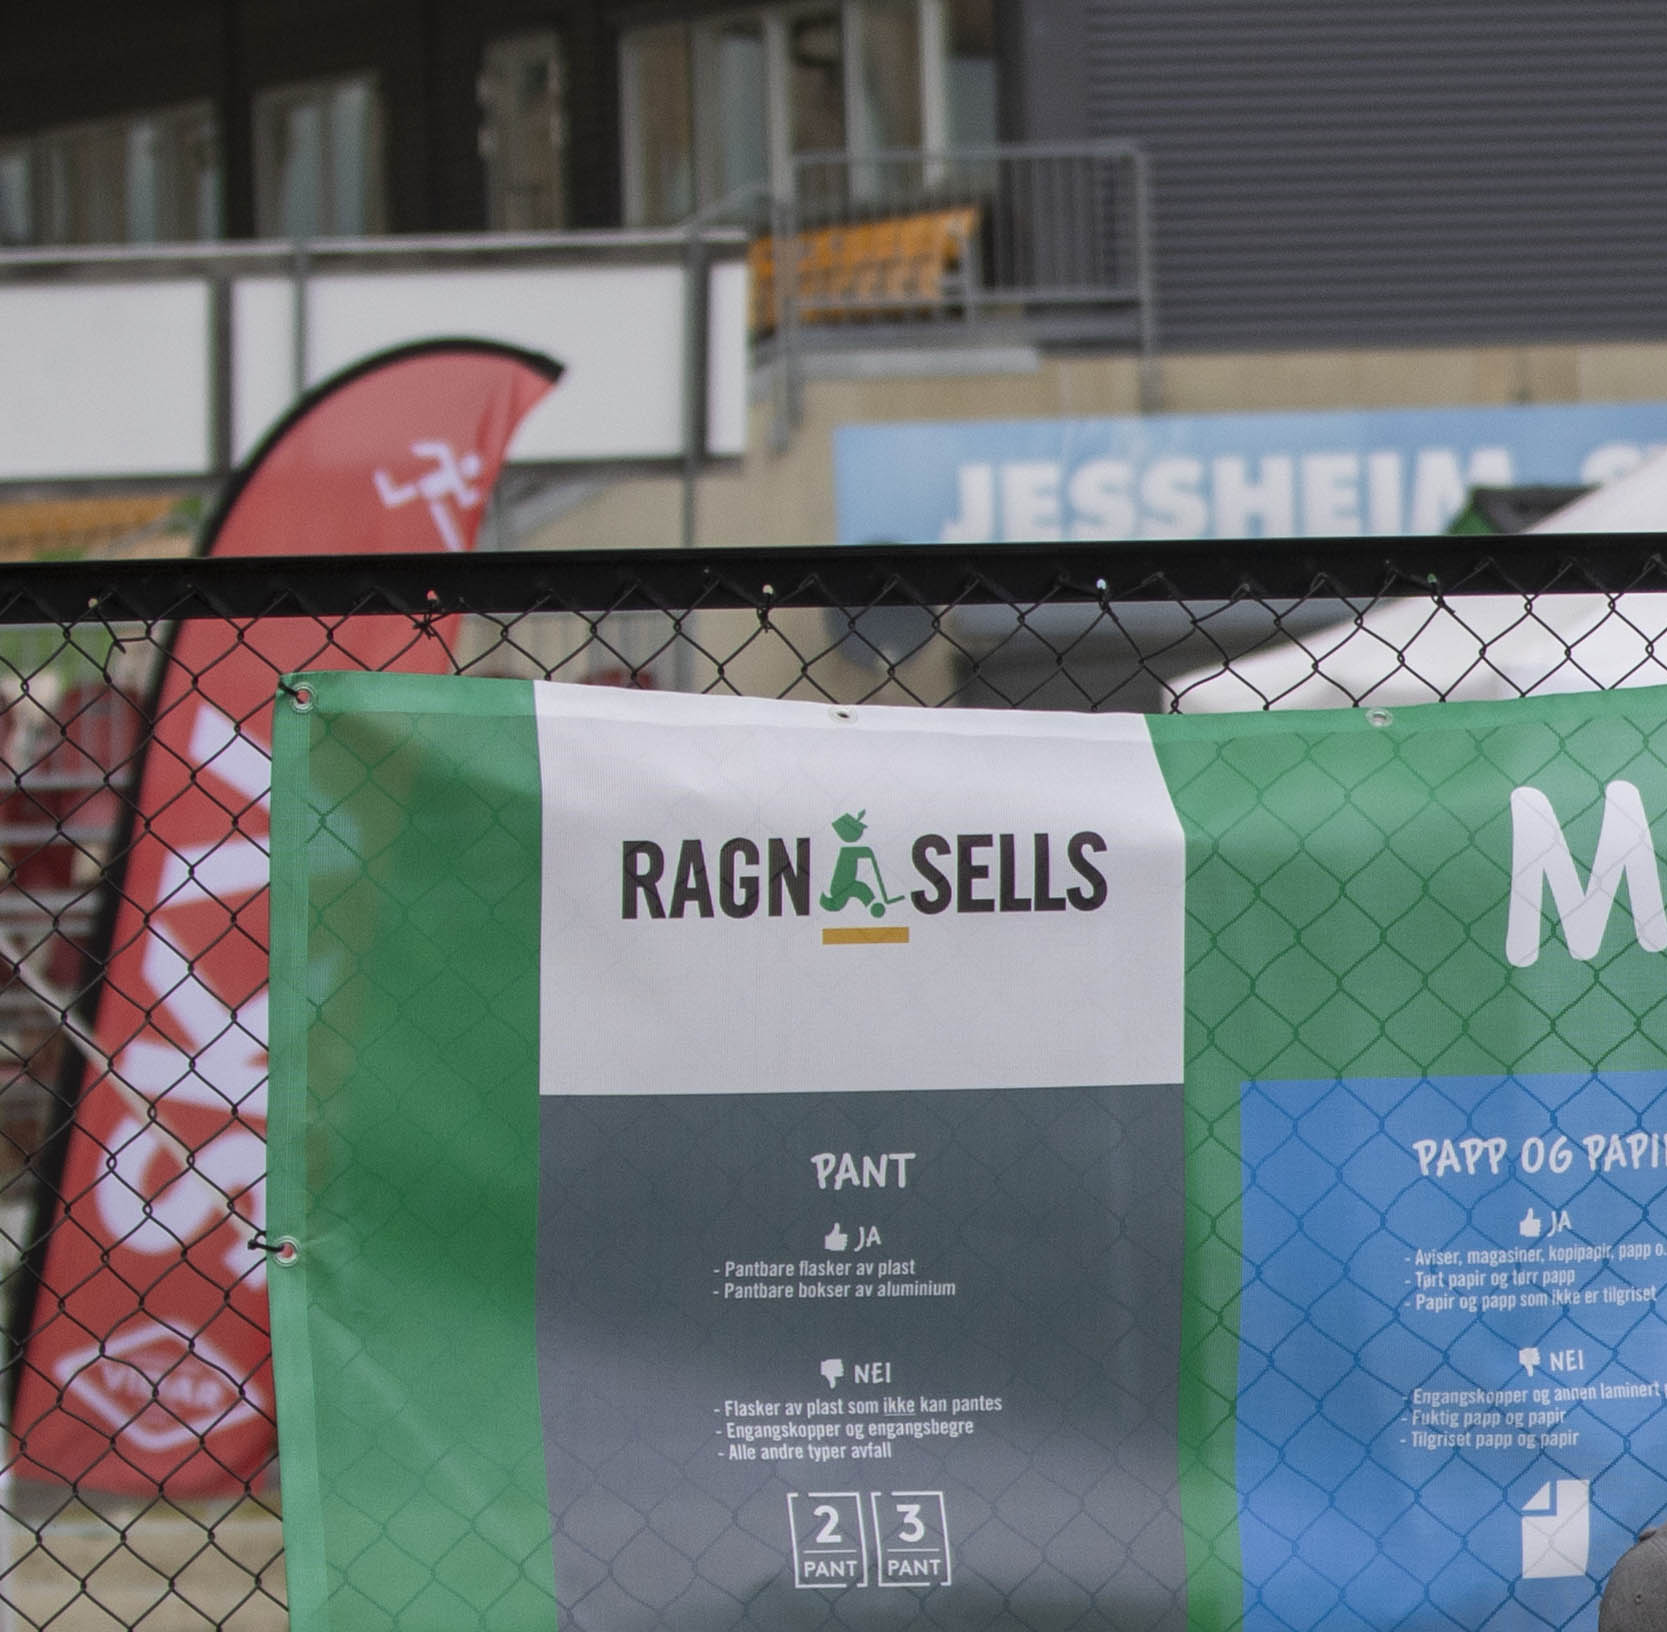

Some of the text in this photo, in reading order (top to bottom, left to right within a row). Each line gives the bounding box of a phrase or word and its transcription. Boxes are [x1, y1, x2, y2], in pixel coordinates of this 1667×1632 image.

[941, 446, 1513, 541] JESSHEIM
[621, 831, 1108, 920] RAGN SELLS
[1412, 1137, 1508, 1177] PAPP
[1520, 1135, 1573, 1174] OG
[811, 1152, 916, 1190] PANT
[1547, 1210, 1572, 1238] JA
[854, 1225, 882, 1252] JA
[725, 1259, 915, 1278] Pantbare flasker av plast
[1415, 1268, 1575, 1290] Tørt papir og tørr papp
[724, 1280, 956, 1299] Pantbare bokser av aluminium
[1416, 1285, 1657, 1312] Papir og papp som ikke er tilgriset
[1550, 1349, 1584, 1372] NEI
[854, 1362, 891, 1384] NEI
[1413, 1387, 1528, 1408] Engangskopper
[1533, 1388, 1550, 1405] og
[1554, 1386, 1596, 1401] annen
[1600, 1381, 1659, 1399] laminert
[725, 1396, 1003, 1419] Flasker av plast som ikke kan pantes
[1412, 1408, 1567, 1428] Fuktig papp og papir
[726, 1419, 974, 1442] Engangskopper og engangsbegre
[1411, 1430, 1580, 1449] Tilgriset papp og papir
[729, 1442, 892, 1463] Alle andre typer avfall
[812, 1504, 843, 1544] 2
[896, 1503, 925, 1543] 3
[804, 1561, 858, 1577] PANT
[887, 1559, 941, 1576] PANT
